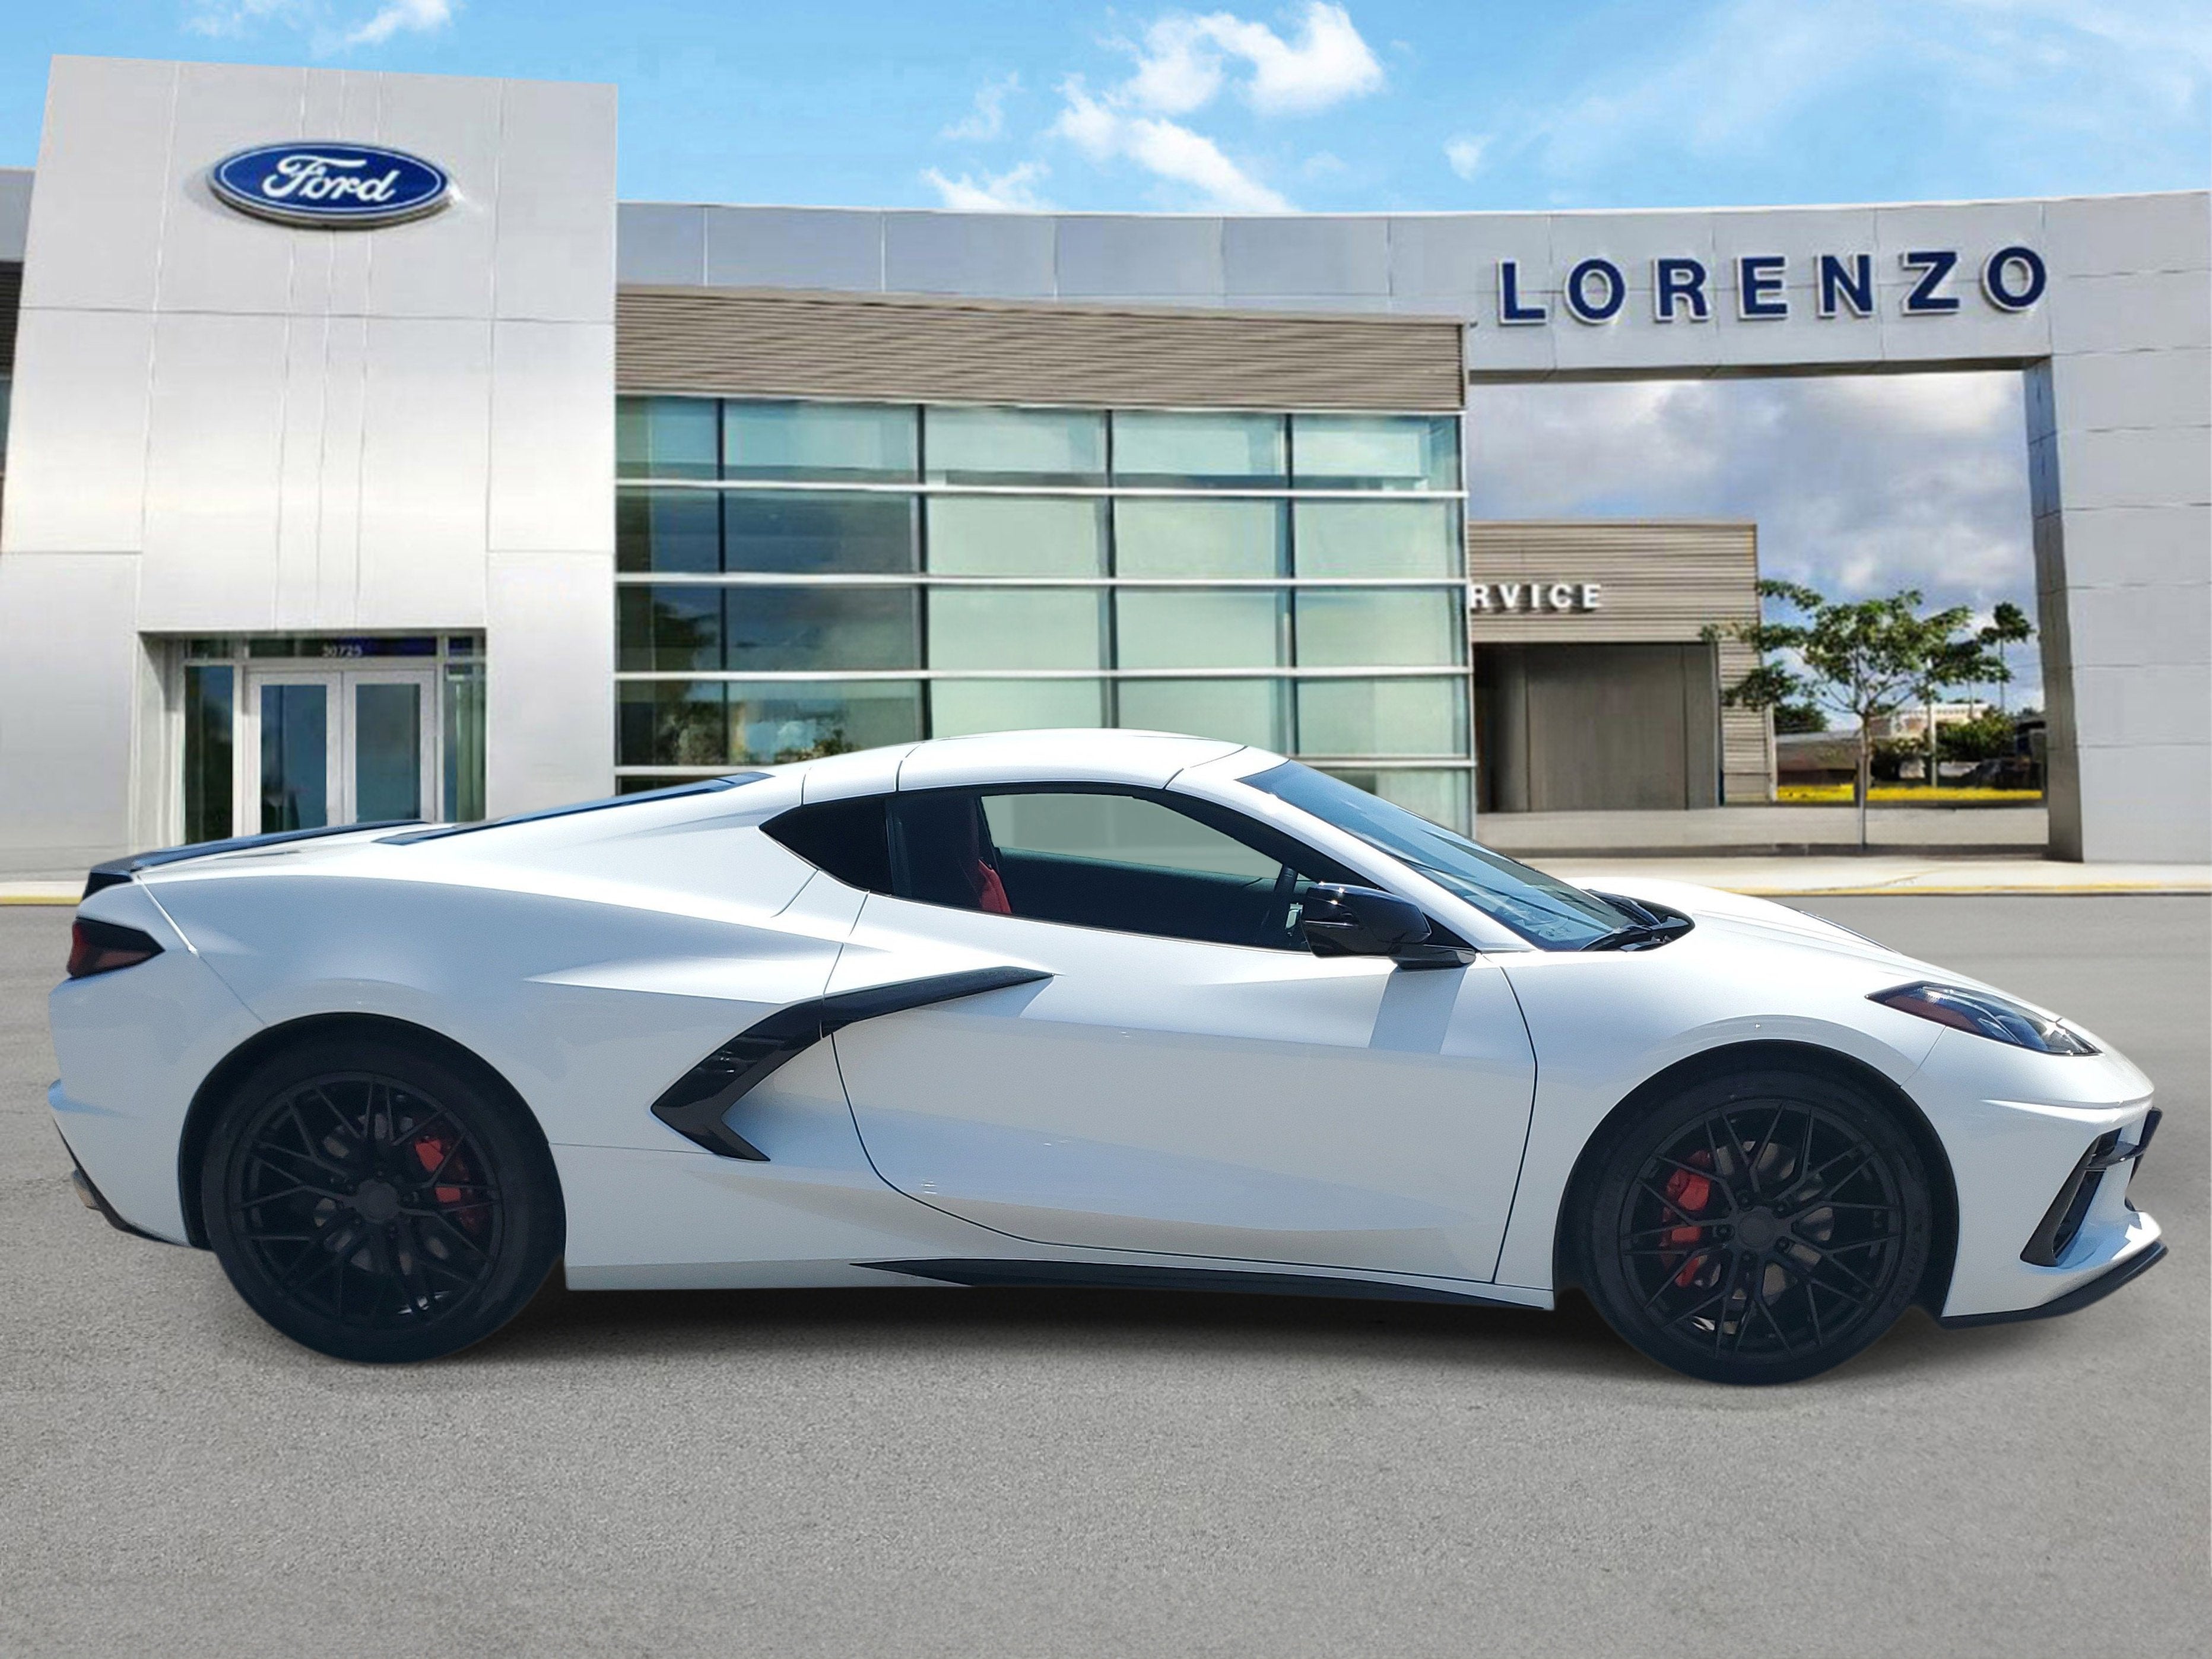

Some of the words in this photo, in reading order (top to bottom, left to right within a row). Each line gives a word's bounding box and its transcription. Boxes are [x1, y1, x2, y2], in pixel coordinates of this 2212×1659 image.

[262, 154, 400, 201] Ford
[1499, 246, 2047, 325] LORENZO
[1470, 583, 1602, 608] RVICE
